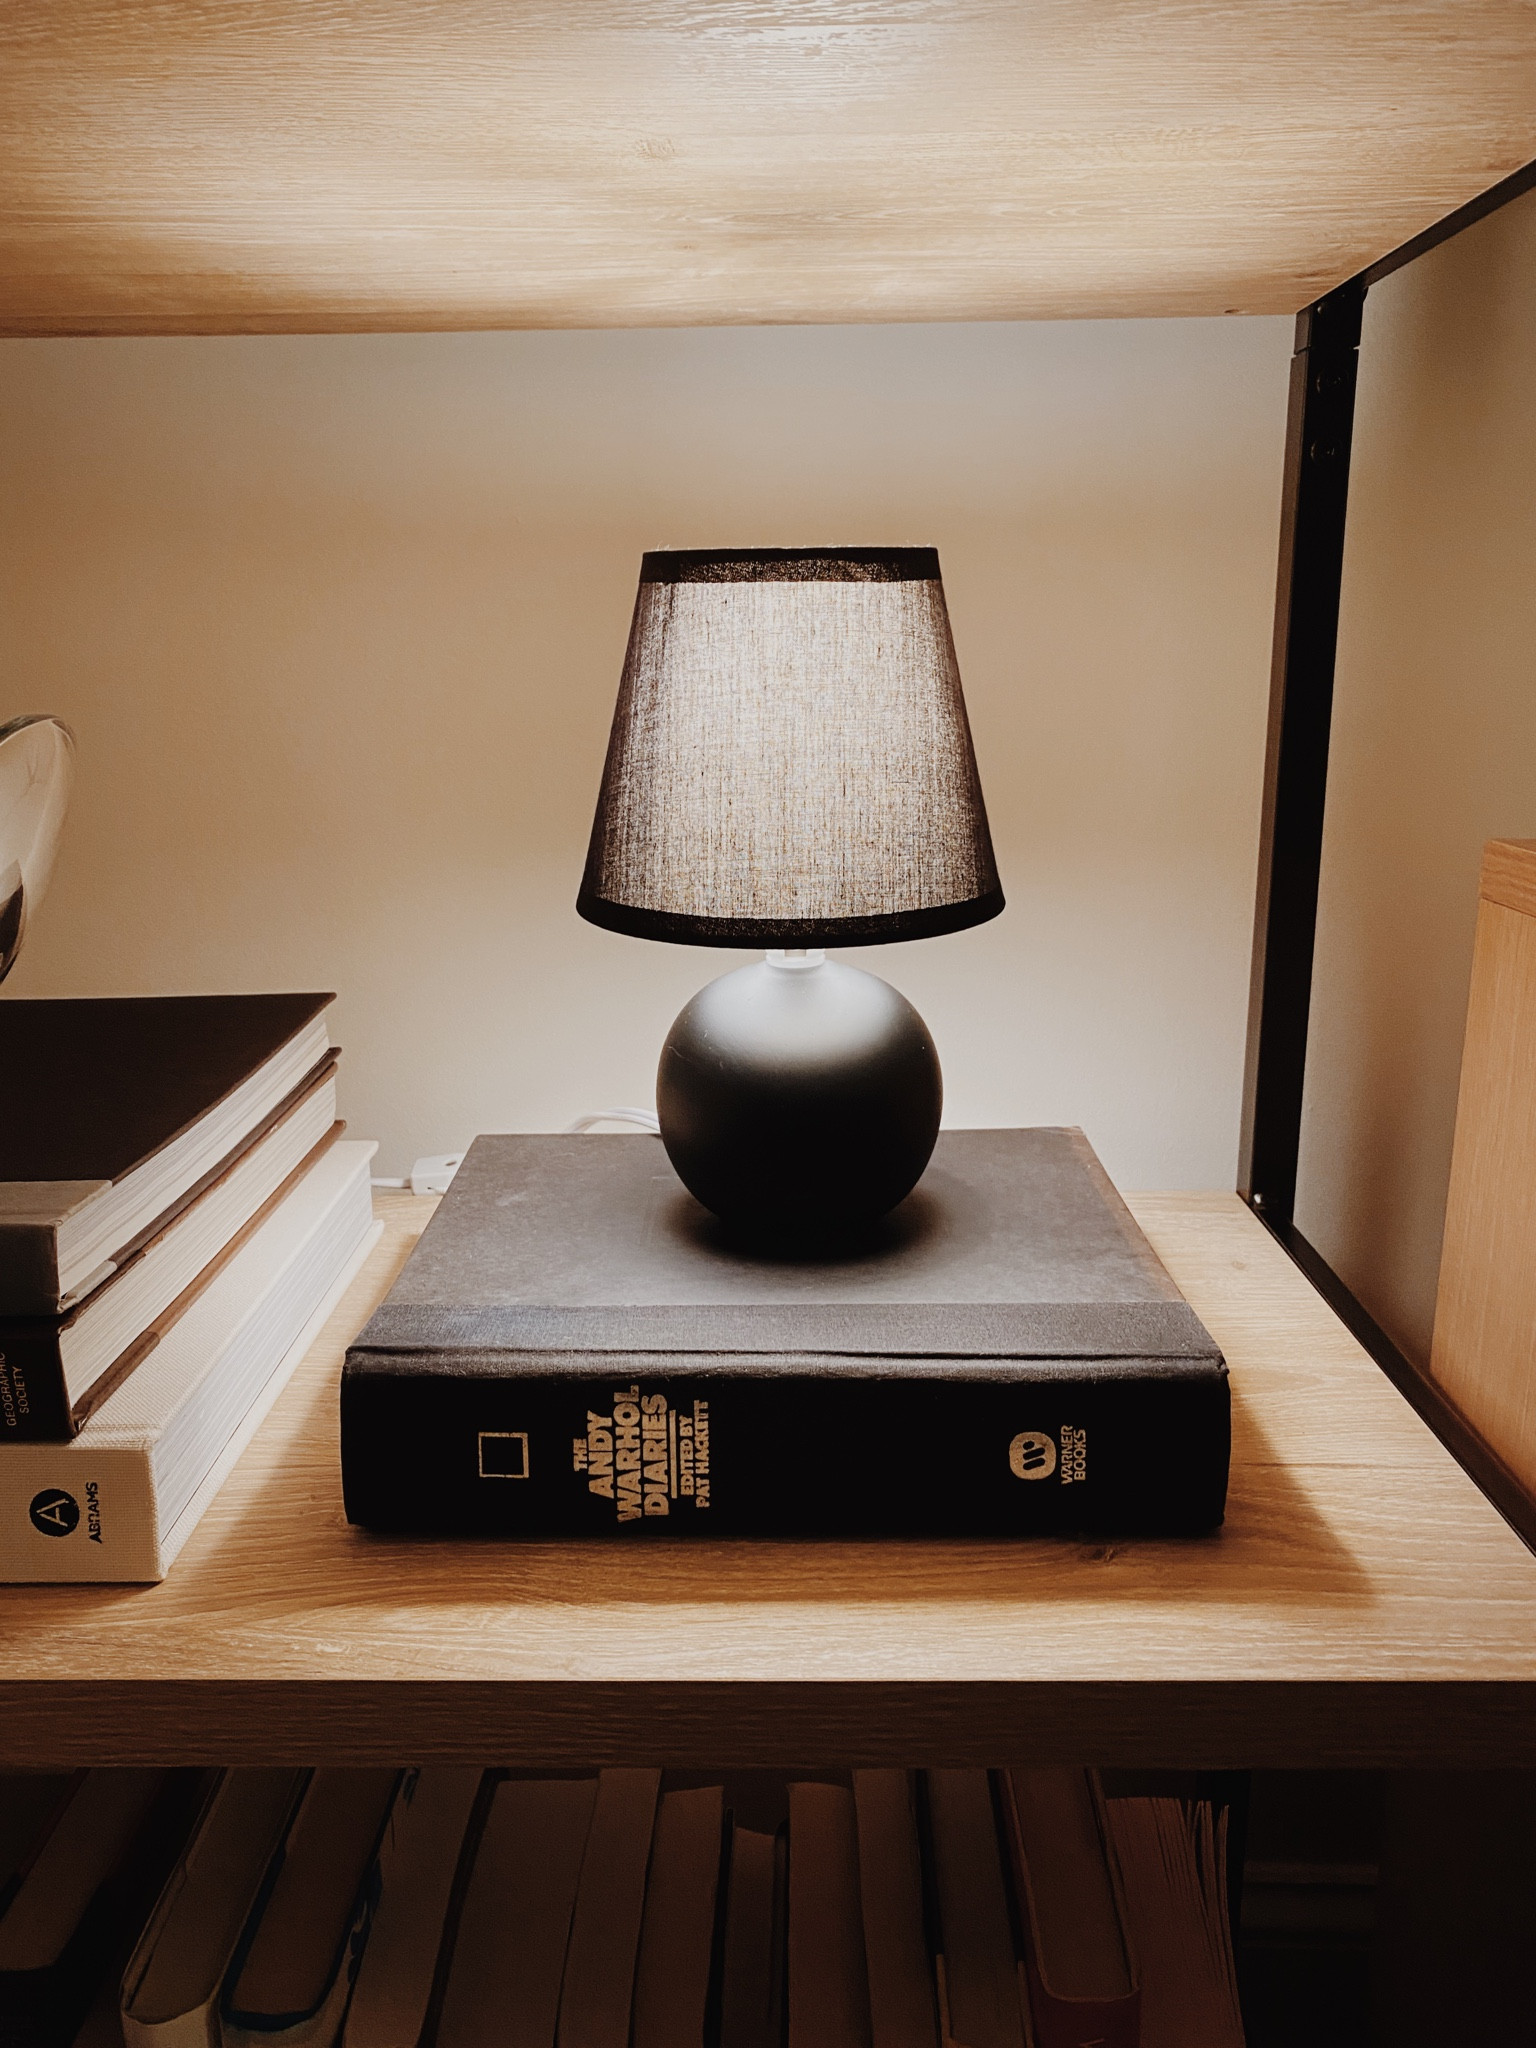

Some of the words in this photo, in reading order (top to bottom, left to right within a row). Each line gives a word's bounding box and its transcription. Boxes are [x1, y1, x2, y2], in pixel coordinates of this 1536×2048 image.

[12, 1365, 30, 1414] SOCIETY
[613, 1385, 642, 1523] WARHOL
[679, 1415, 693, 1437] BY
[694, 1399, 710, 1474] HACKETT
[573, 1438, 588, 1471] THE
[587, 1410, 614, 1499] ANDY
[641, 1394, 669, 1515] DIARIES
[679, 1439, 694, 1495] EDITED
[1061, 1425, 1073, 1485] WARNER
[1073, 1429, 1086, 1480] BOOKS
[36, 1498, 69, 1527] A
[86, 1481, 103, 1544] ABRAMS
[695, 1477, 710, 1508] PAT
